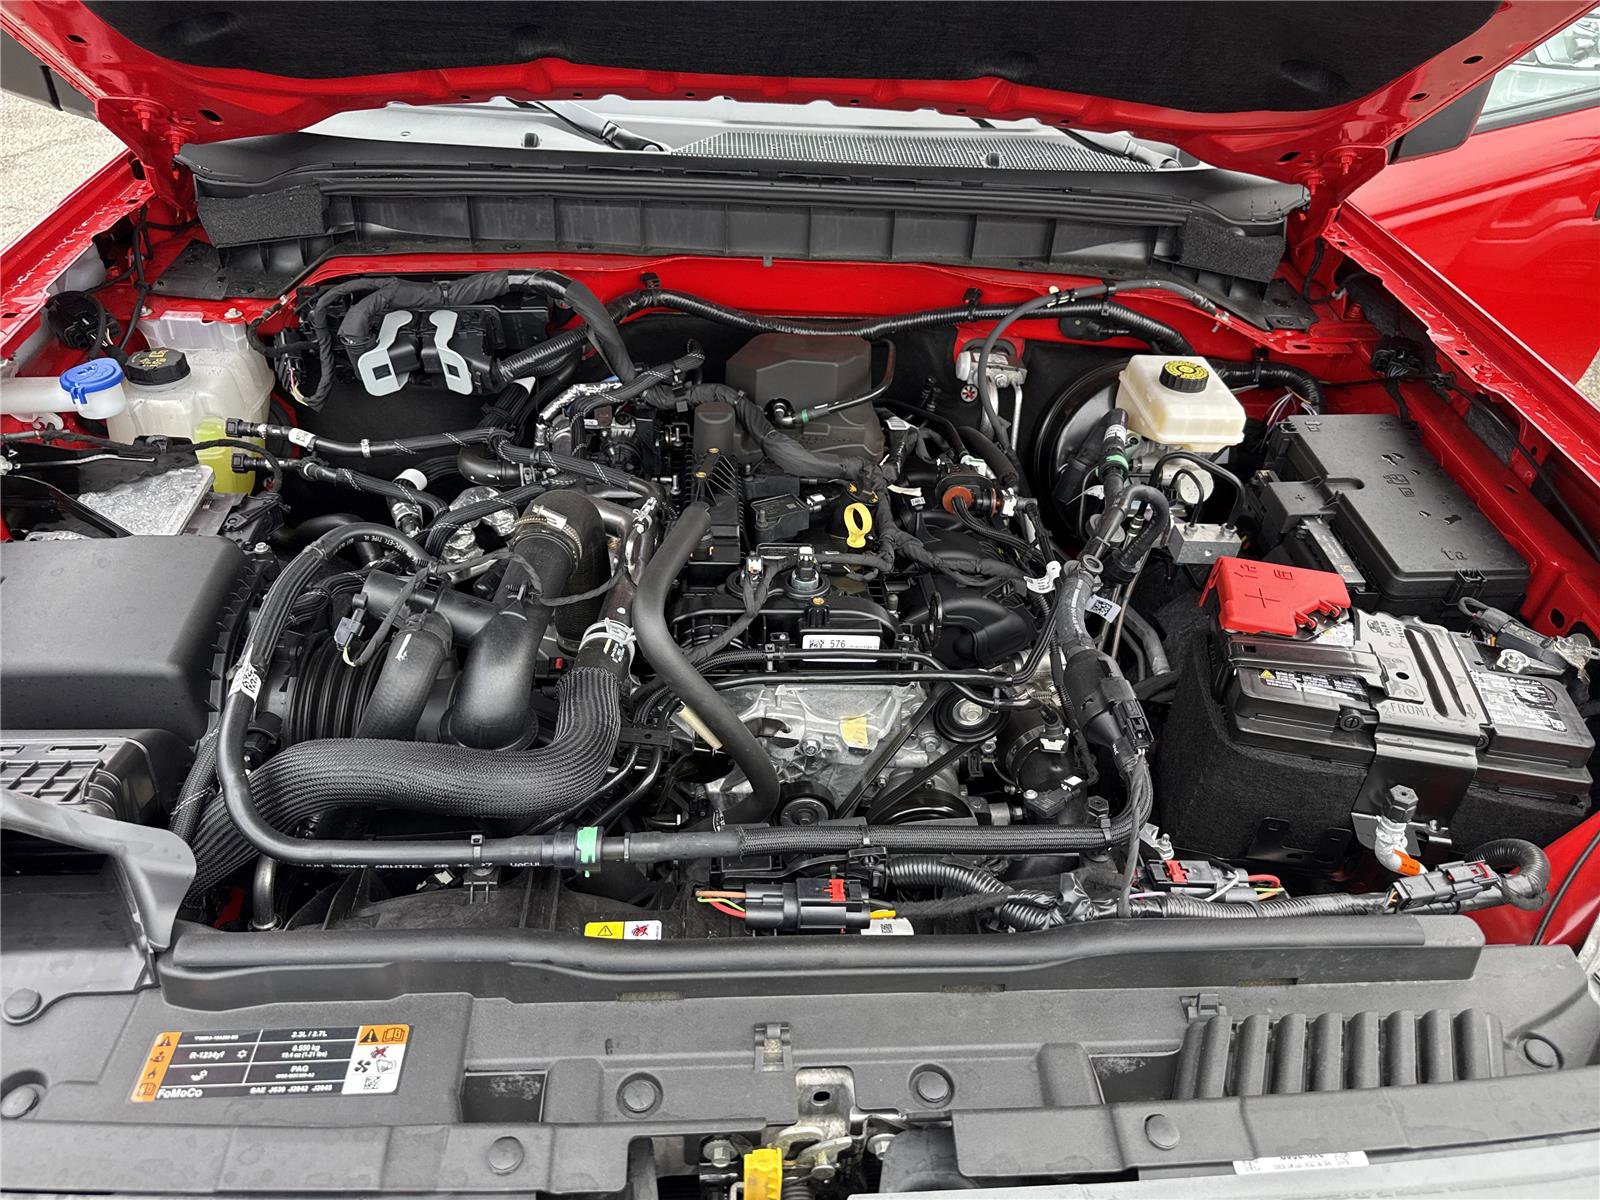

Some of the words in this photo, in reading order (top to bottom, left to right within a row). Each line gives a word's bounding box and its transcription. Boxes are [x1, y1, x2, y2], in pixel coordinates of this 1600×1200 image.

[829, 639, 846, 648] 576
[1390, 702, 1430, 717] FRONT
[189, 1050, 226, 1060] R-1234yf
[156, 1087, 204, 1099] FoMoCo
